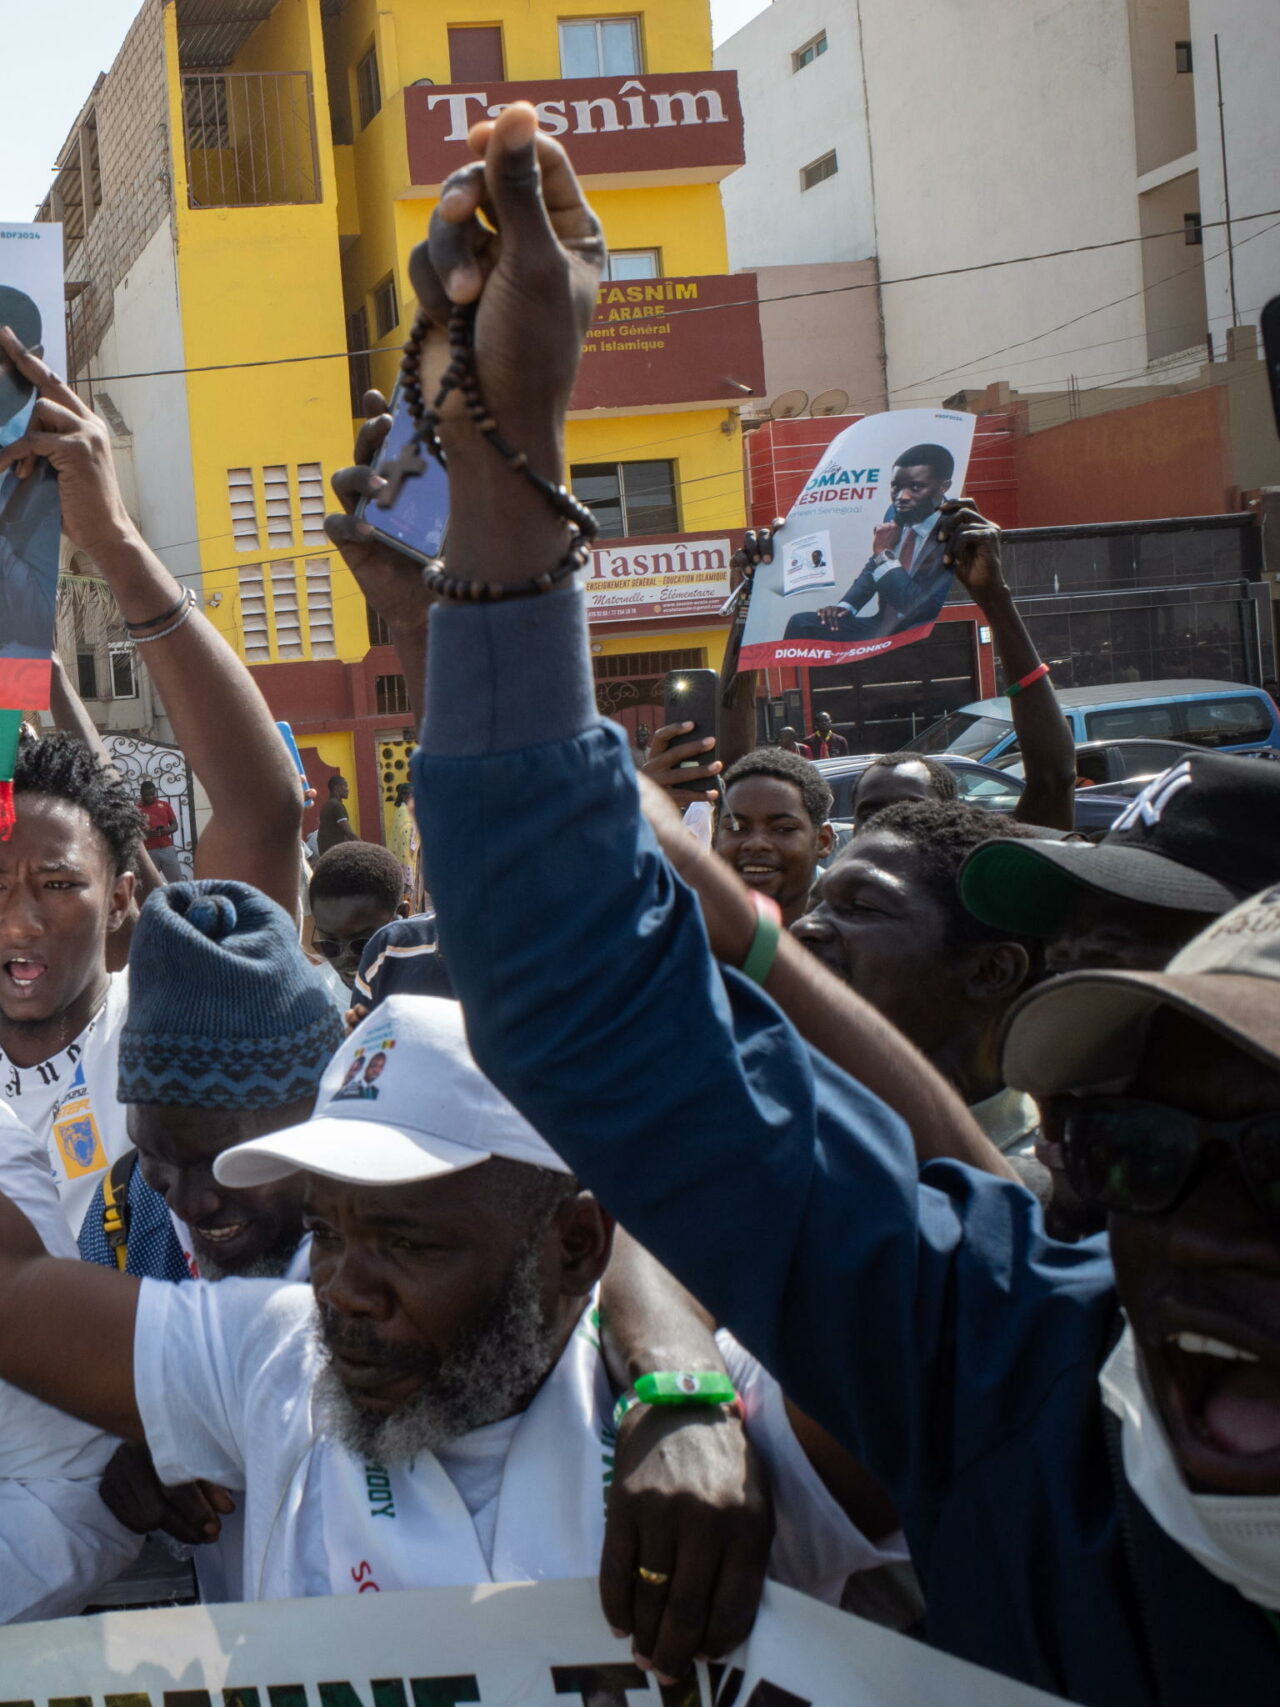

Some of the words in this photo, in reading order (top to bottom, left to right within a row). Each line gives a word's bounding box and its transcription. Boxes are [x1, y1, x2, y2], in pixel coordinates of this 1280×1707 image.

[608, 305, 665, 321] ARABE
[619, 323, 671, 337] Général
[590, 544, 727, 579] Tasnîm
[592, 591, 645, 605] Maternelle
[660, 586, 715, 601] Élémentaire
[775, 648, 832, 659] DIOMAYE
[848, 640, 892, 656] SONKO
